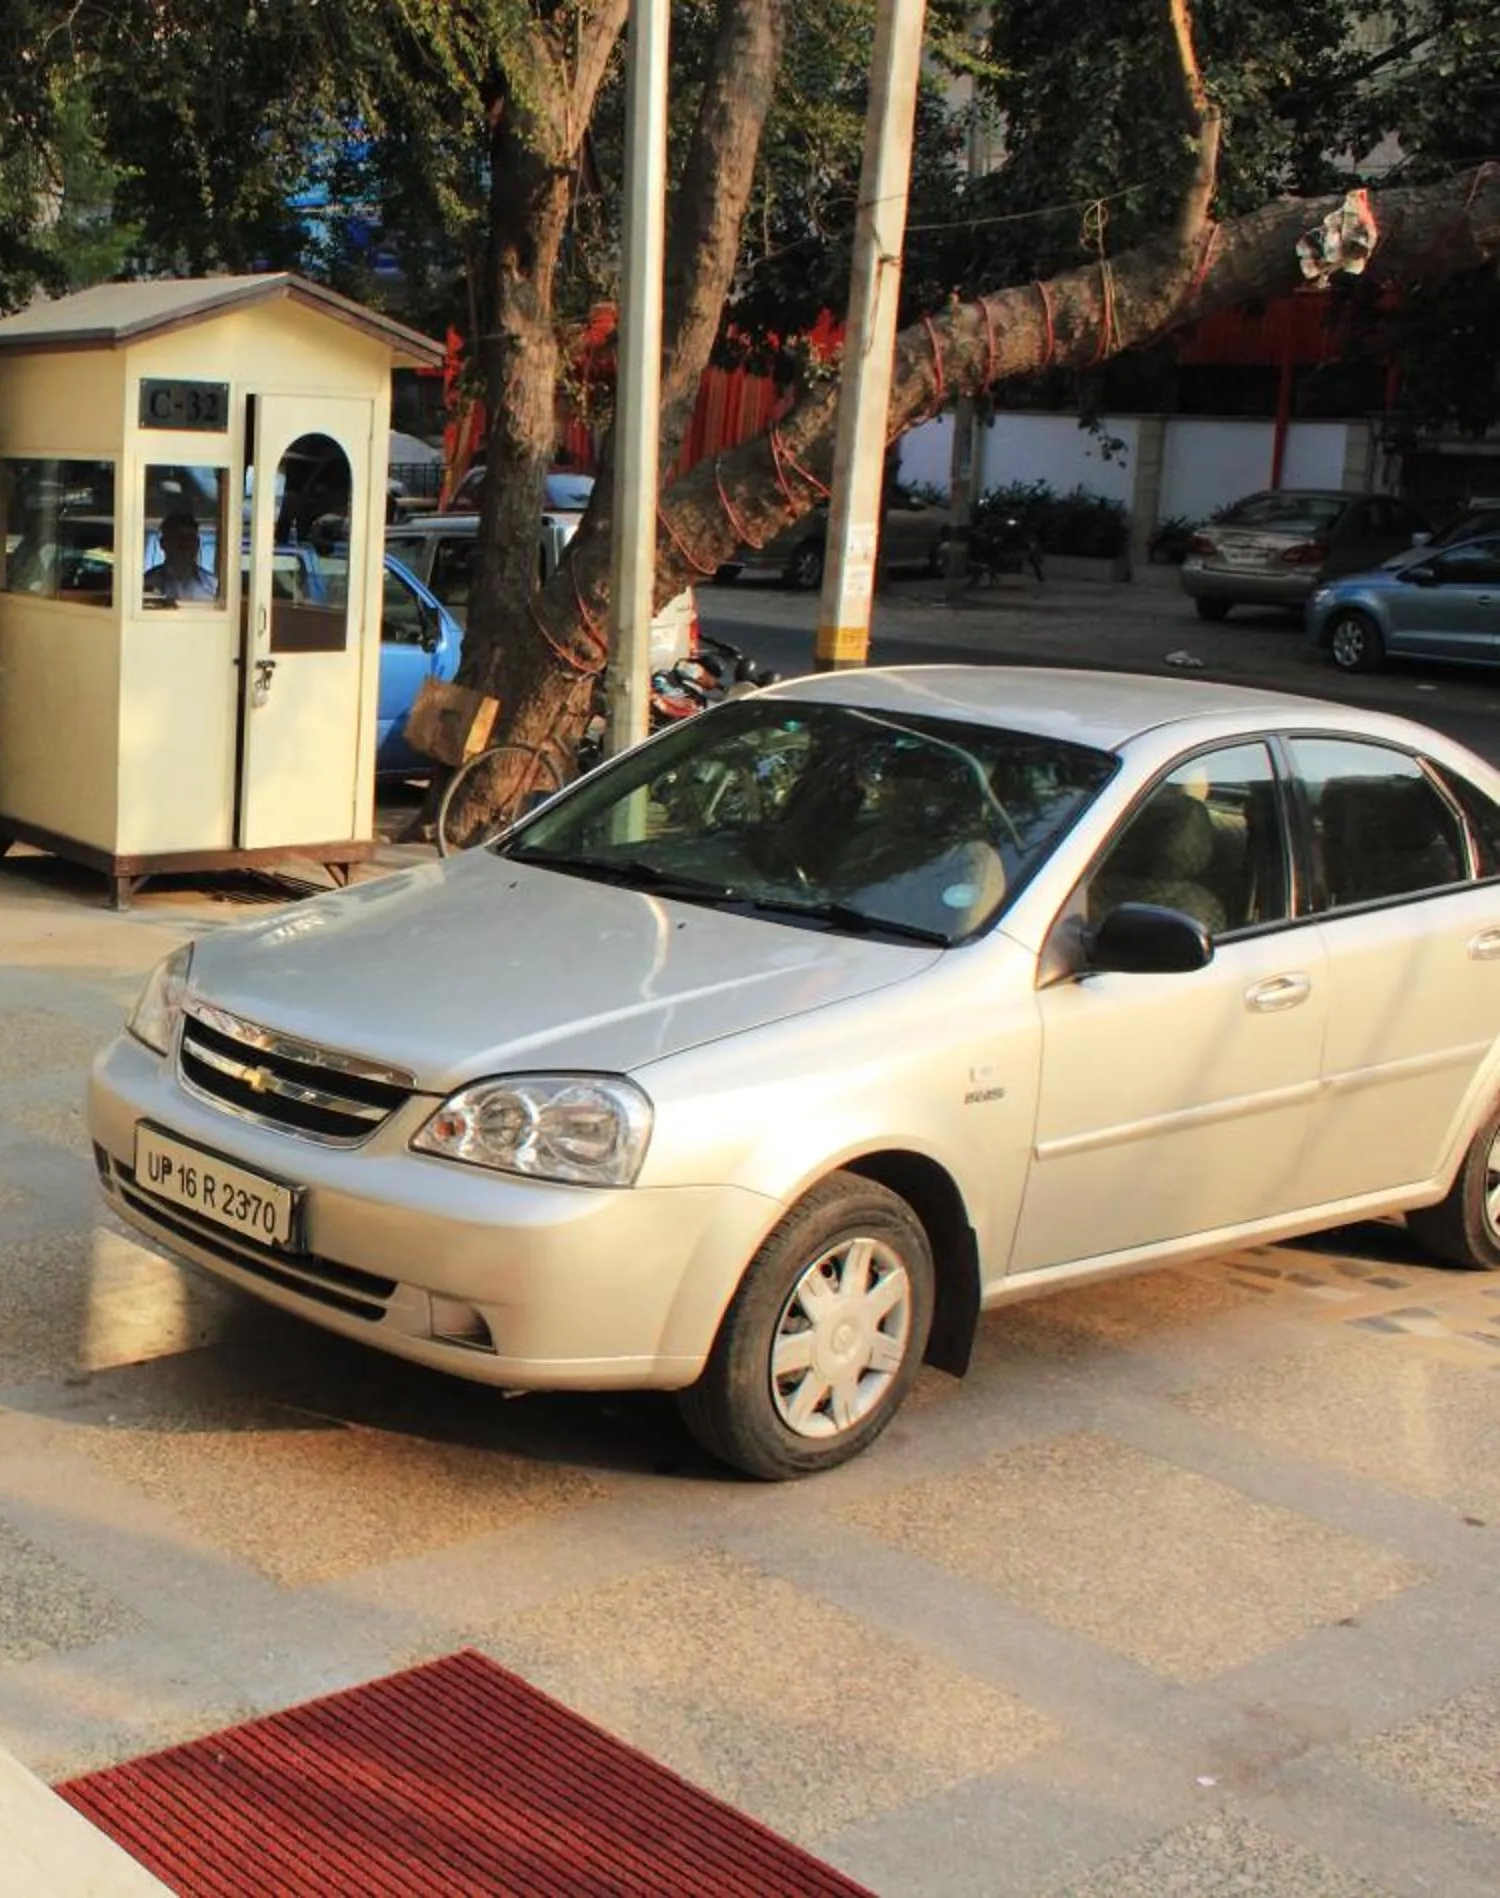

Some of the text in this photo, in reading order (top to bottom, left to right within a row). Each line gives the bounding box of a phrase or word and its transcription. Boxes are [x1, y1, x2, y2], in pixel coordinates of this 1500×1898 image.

[149, 388, 219, 423] C-32
[148, 1151, 277, 1234] UP 16 R 2370
